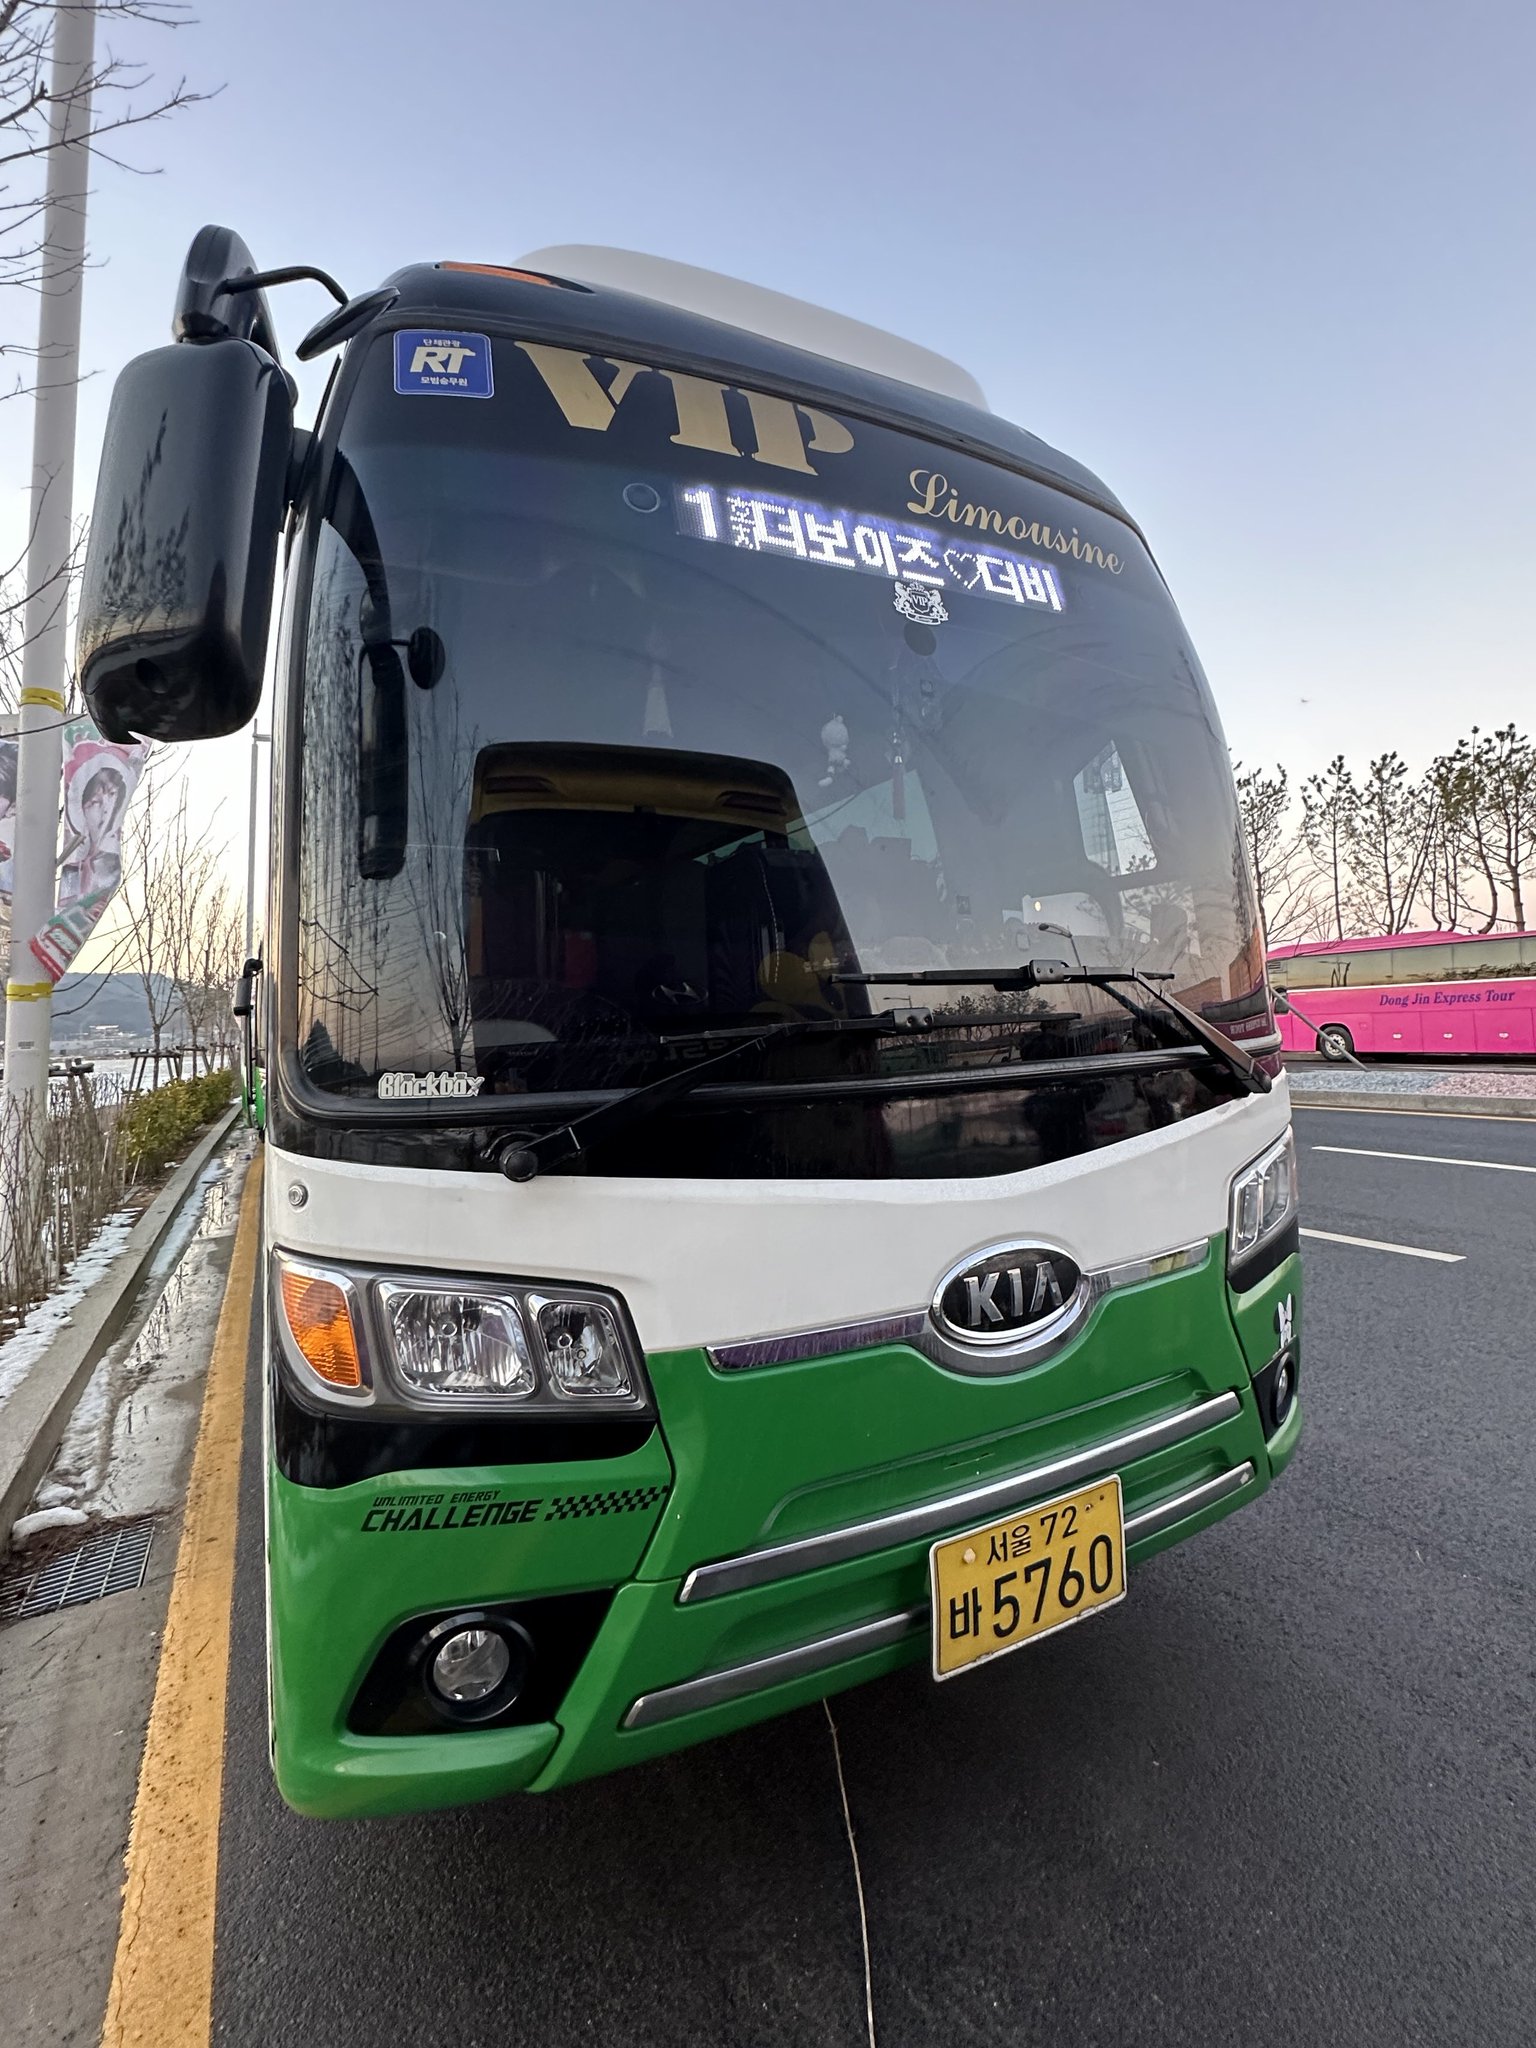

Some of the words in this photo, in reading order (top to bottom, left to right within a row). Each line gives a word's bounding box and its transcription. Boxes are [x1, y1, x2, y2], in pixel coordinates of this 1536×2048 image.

[410, 346, 476, 374] RT
[420, 376, 468, 387] 모범승무원
[514, 341, 855, 476] VIP
[907, 469, 1125, 574] Limousine
[912, 595, 928, 607] VIP
[1379, 994, 1410, 1008] Dong
[1412, 992, 1430, 1006] Jin
[1433, 992, 1481, 1006] Express
[1486, 990, 1516, 1002] Tour
[378, 1072, 485, 1099] Blackbox
[963, 1261, 1064, 1327] KIA
[373, 1494, 444, 1507] UNLIMITED
[450, 1490, 501, 1504] ENERGY
[360, 1499, 543, 1532] CHALLENGE
